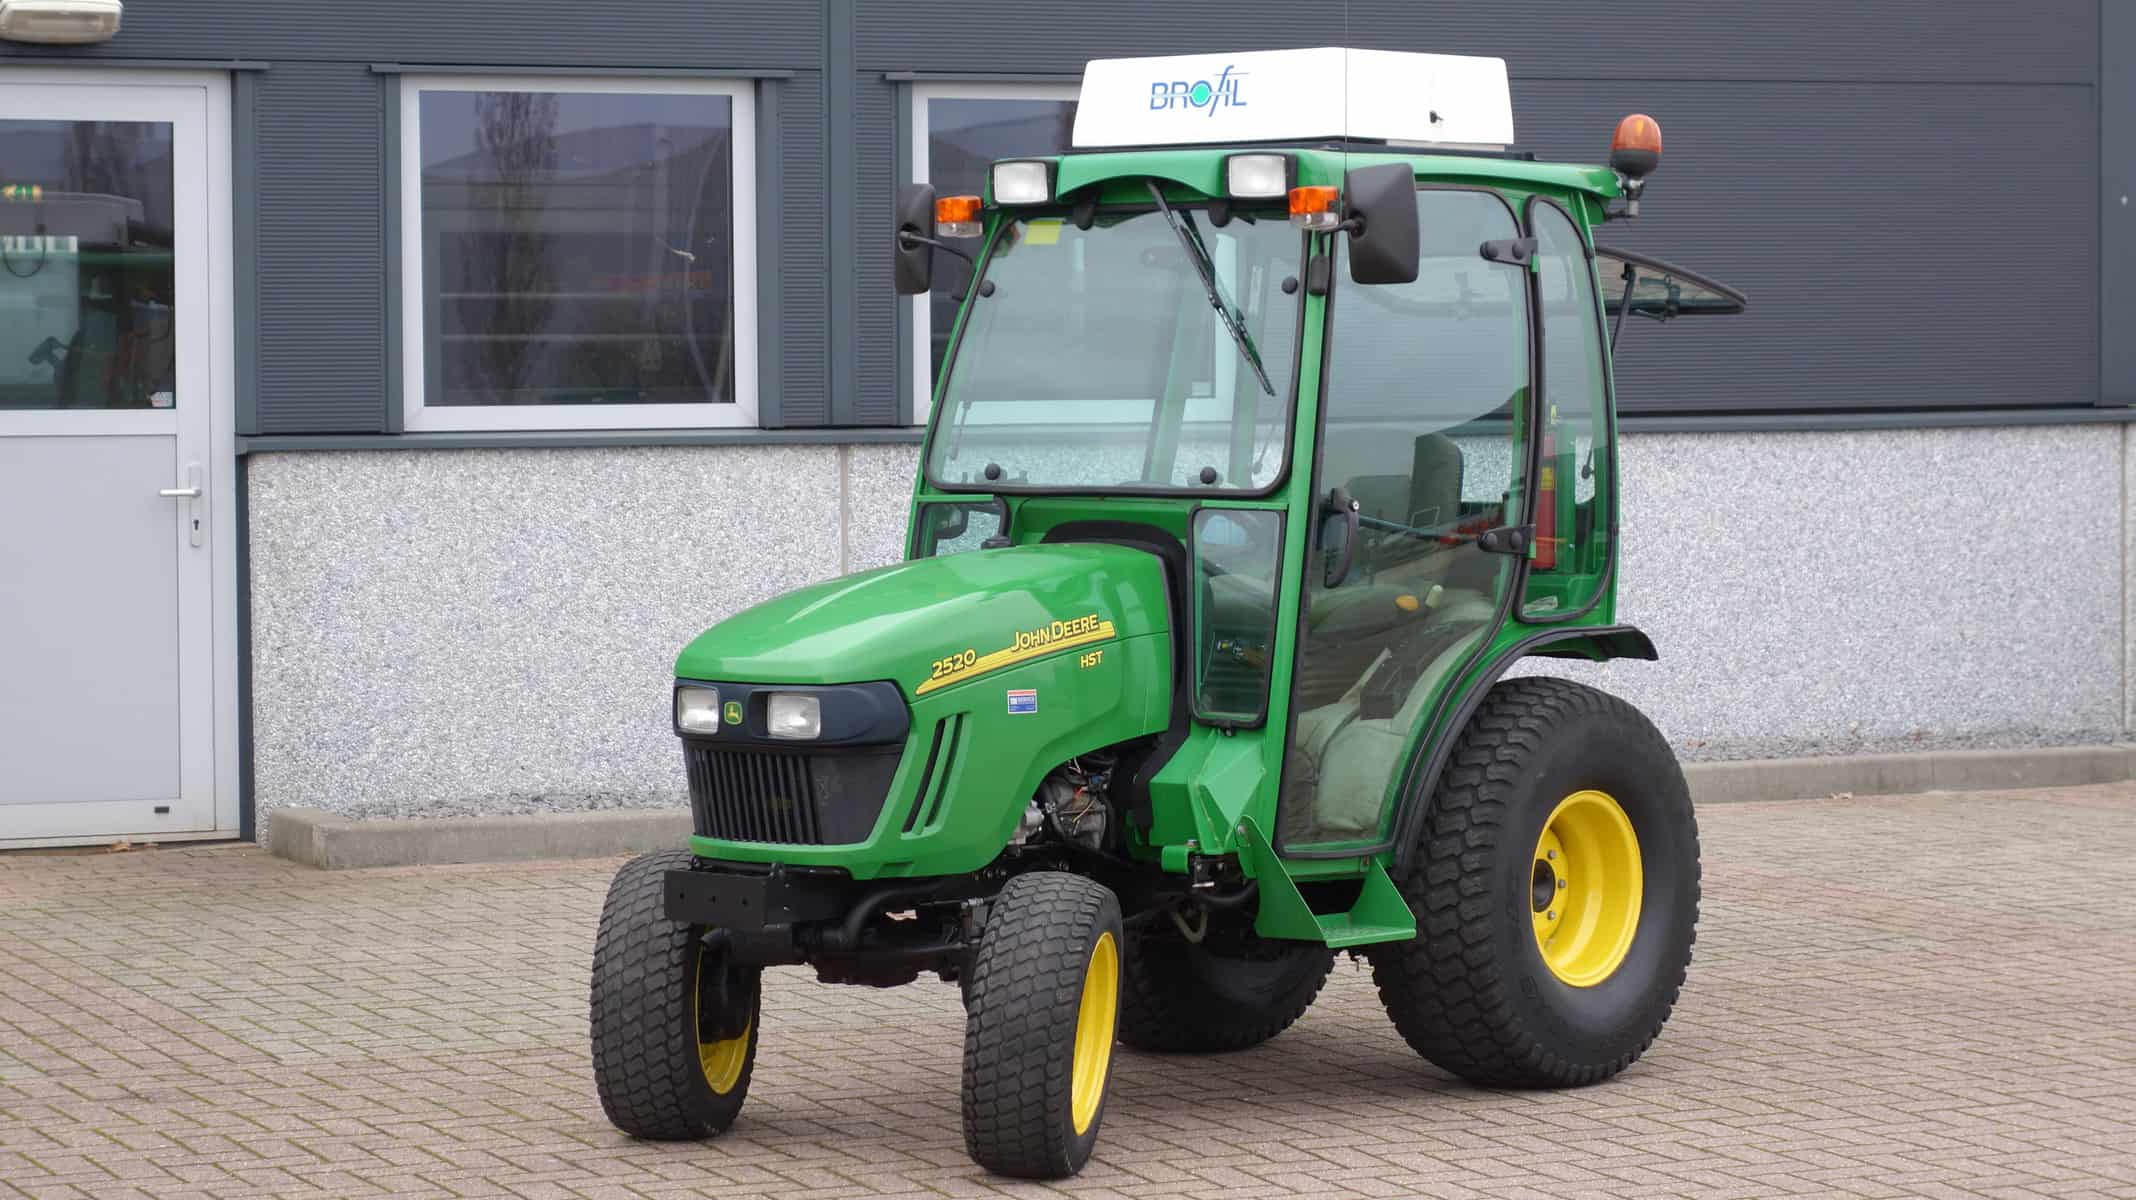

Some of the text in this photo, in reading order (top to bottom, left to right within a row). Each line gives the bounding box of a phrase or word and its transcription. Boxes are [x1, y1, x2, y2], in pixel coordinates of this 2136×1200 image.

[1011, 614, 1099, 652] JOHN DEERE
[932, 649, 976, 679] 2520
[1080, 650, 1103, 668] HST
